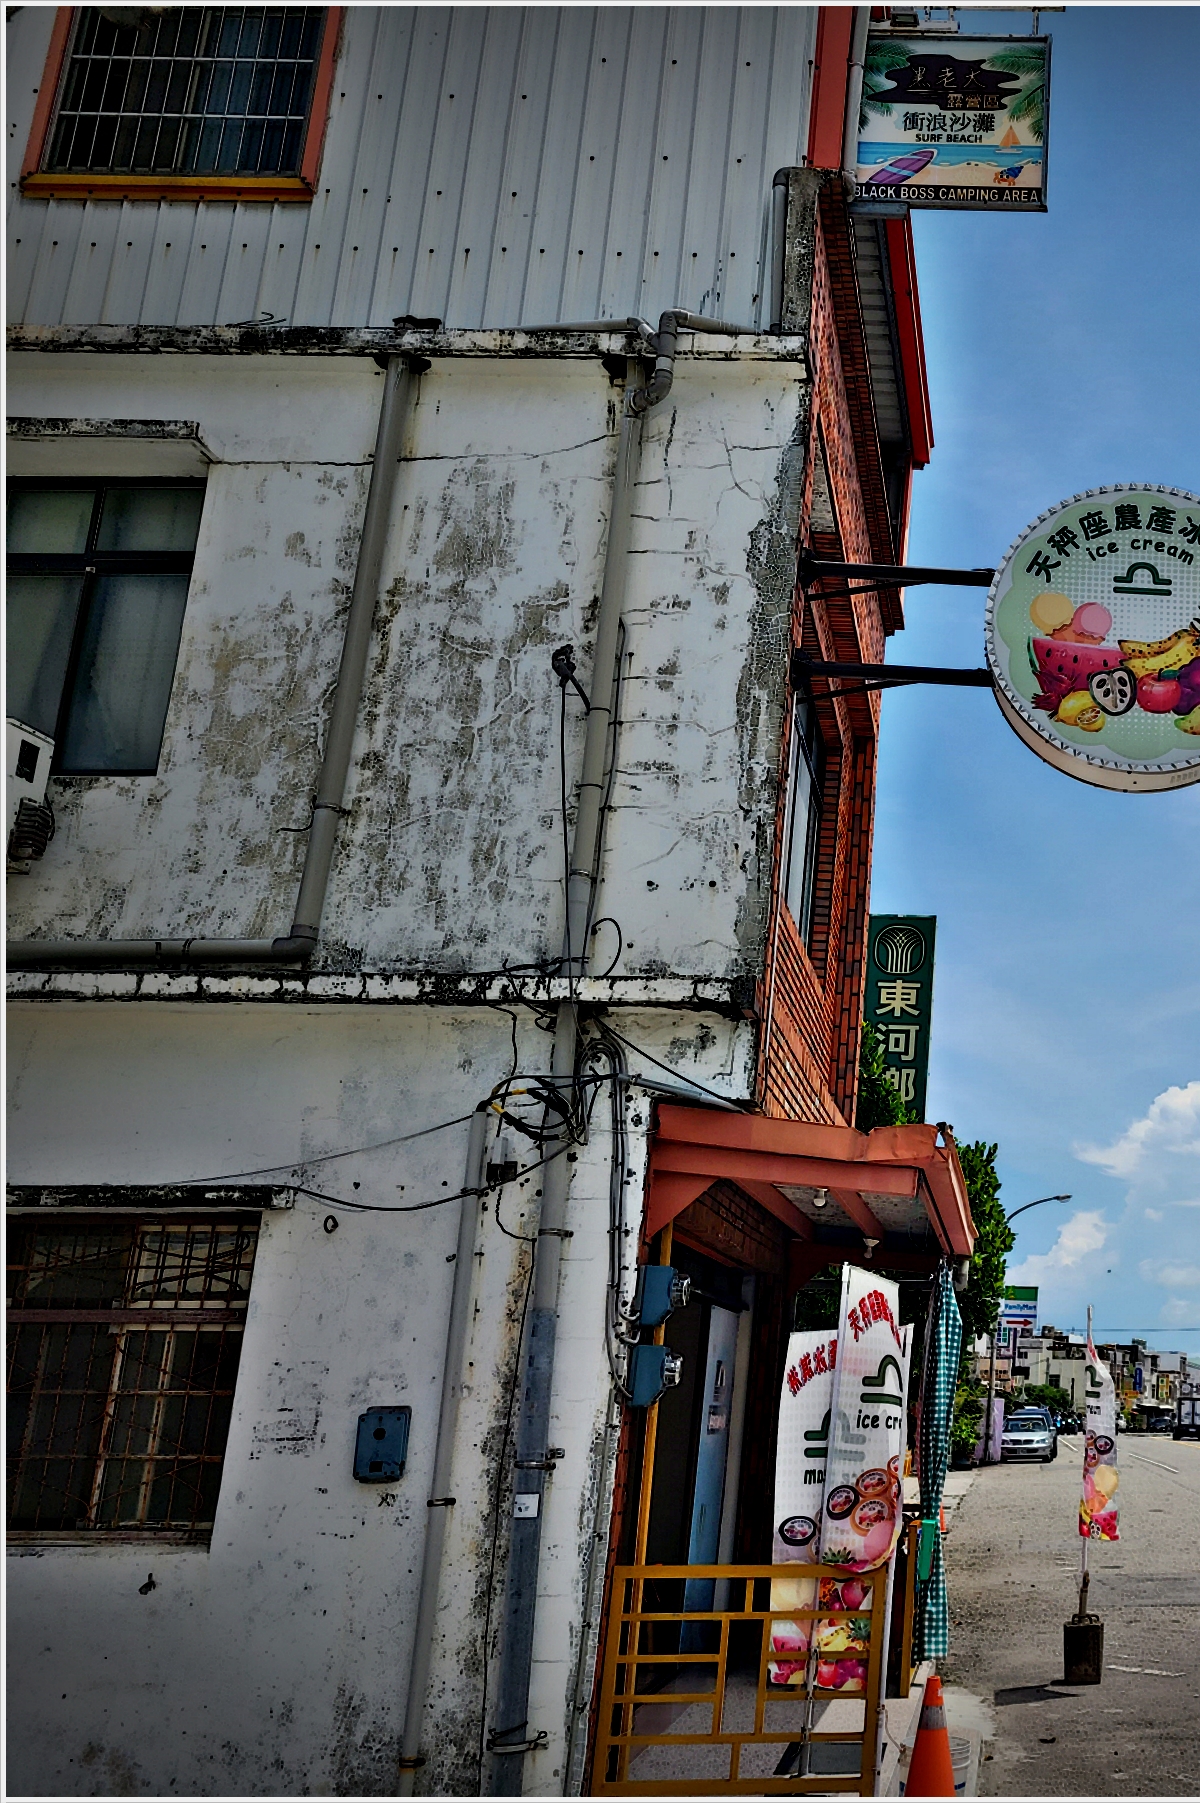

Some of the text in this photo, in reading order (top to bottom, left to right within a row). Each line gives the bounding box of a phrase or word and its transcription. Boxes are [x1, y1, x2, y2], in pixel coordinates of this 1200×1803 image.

[902, 111, 996, 133] 衝浪沙灘
[915, 133, 983, 143] SURF BEACH
[854, 185, 1039, 201] BLACK BOSS CAMPING AREA
[1086, 538, 1194, 565] ice cream
[856, 1408, 880, 1430] ice
